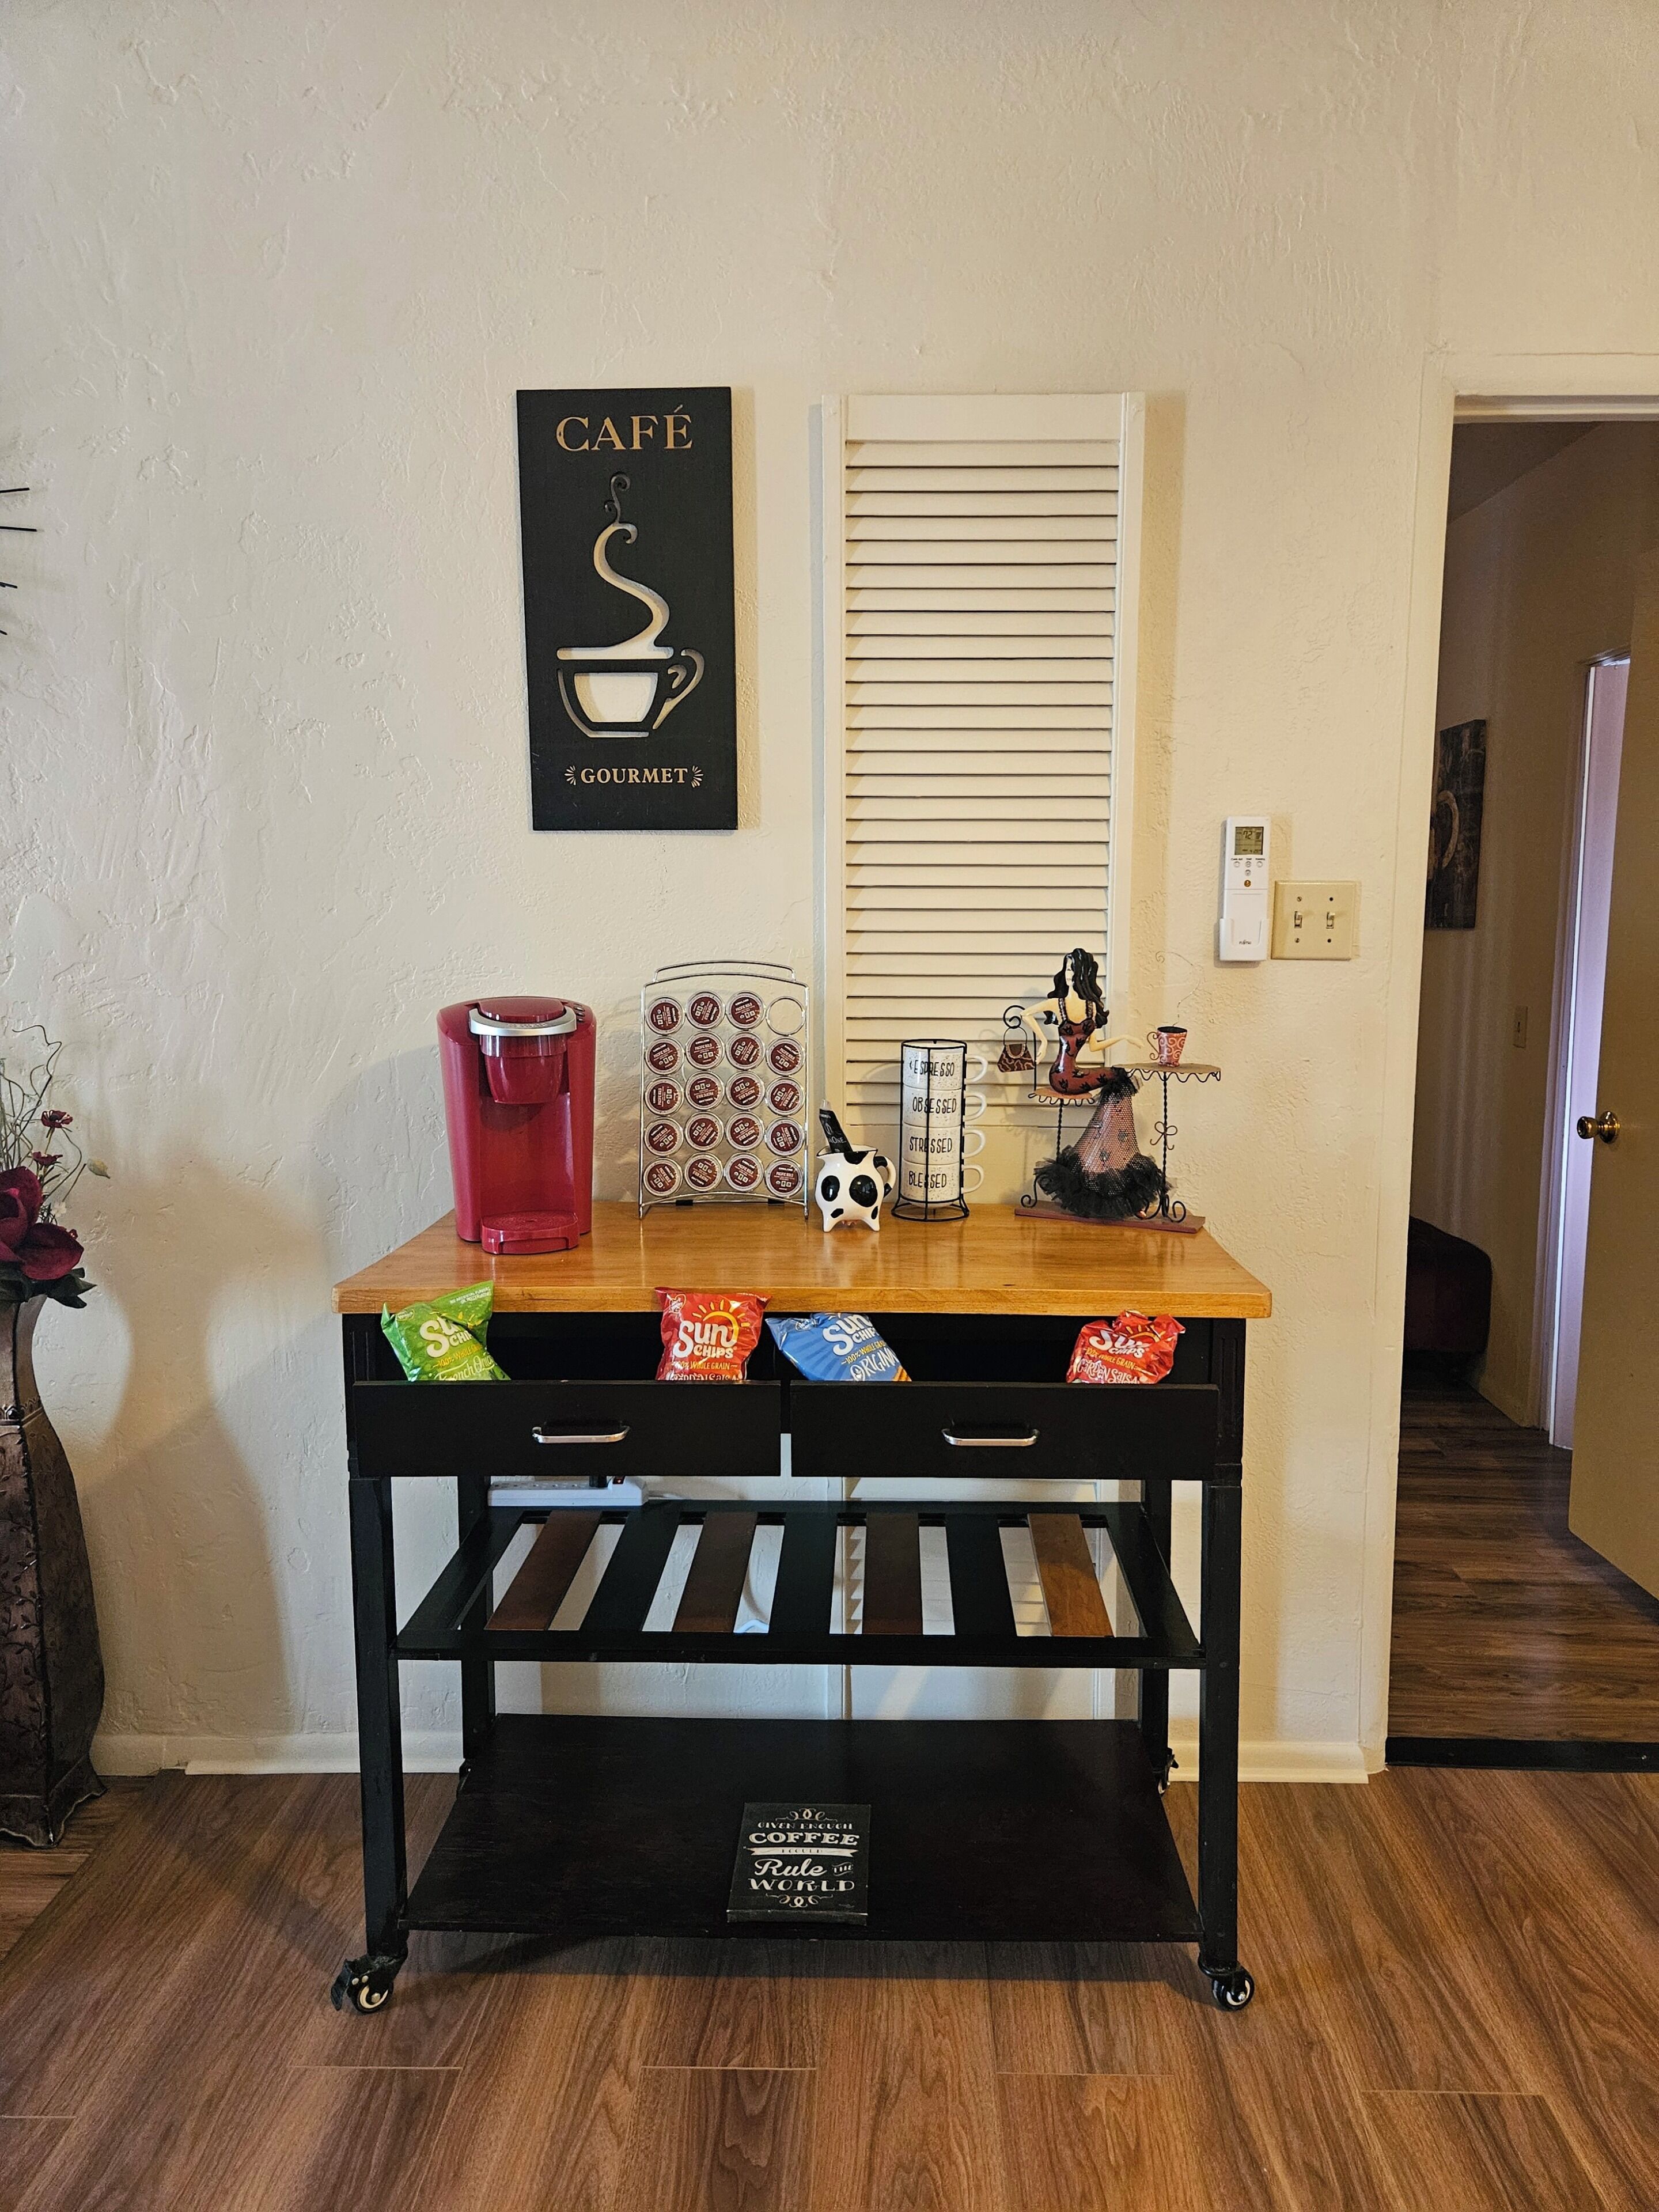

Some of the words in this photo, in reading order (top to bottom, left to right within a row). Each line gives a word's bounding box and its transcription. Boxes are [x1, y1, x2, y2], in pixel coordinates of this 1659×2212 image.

[556, 404, 692, 452] CAFÉ
[581, 768, 688, 784] GOURMET
[914, 1059, 955, 1077] ESPRESSO
[913, 1096, 956, 1113] OBSESSED
[909, 1171, 946, 1188] BLESED
[693, 1344, 734, 1359] CHIPS
[1108, 1347, 1145, 1358] CHIPS
[711, 1362, 730, 1370] GRAIN
[1116, 1357, 1137, 1370] GRAIN
[749, 1832, 859, 1846] COFFEE
[755, 1858, 827, 1876] Rule
[748, 1878, 855, 1892] WORLD
